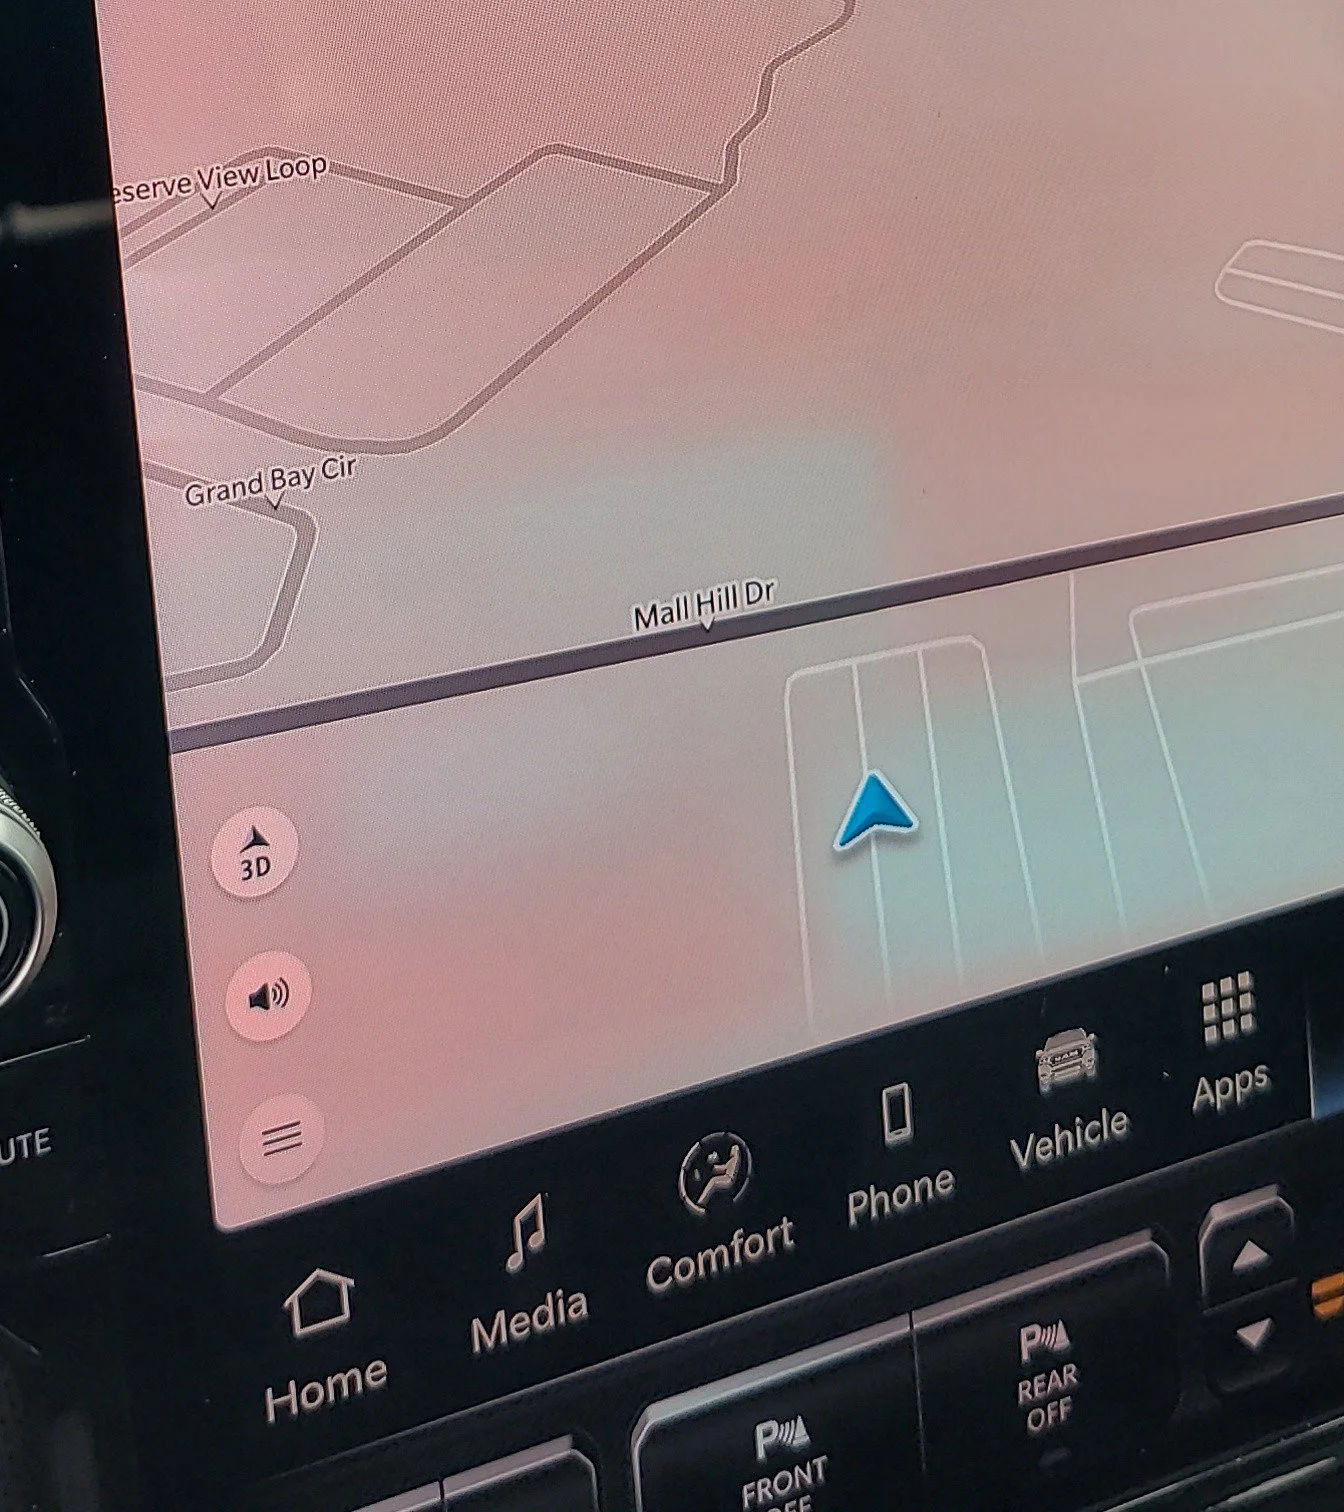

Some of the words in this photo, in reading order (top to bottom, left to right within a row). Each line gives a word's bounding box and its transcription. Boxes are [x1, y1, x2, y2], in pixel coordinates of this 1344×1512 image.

[196, 164, 260, 190] View
[265, 155, 328, 182] Loop
[185, 471, 263, 507] Grand
[271, 466, 316, 491] Bay
[321, 454, 357, 479] Cir
[633, 595, 689, 632] Mall
[696, 584, 738, 617] Hill
[745, 580, 775, 606] Dr
[240, 856, 271, 881] 3D
[1191, 1061, 1271, 1115] Apps
[1009, 1107, 1131, 1171] Vehicle
[847, 1166, 956, 1229] Phone
[644, 1215, 797, 1293] Comfort
[469, 1288, 589, 1354] Media
[264, 1358, 389, 1424] Home
[1018, 1363, 1078, 1405] REAR
[1026, 1395, 1073, 1431] OFF
[742, 1454, 828, 1509] FRONT
[767, 1494, 812, 1512] FF
